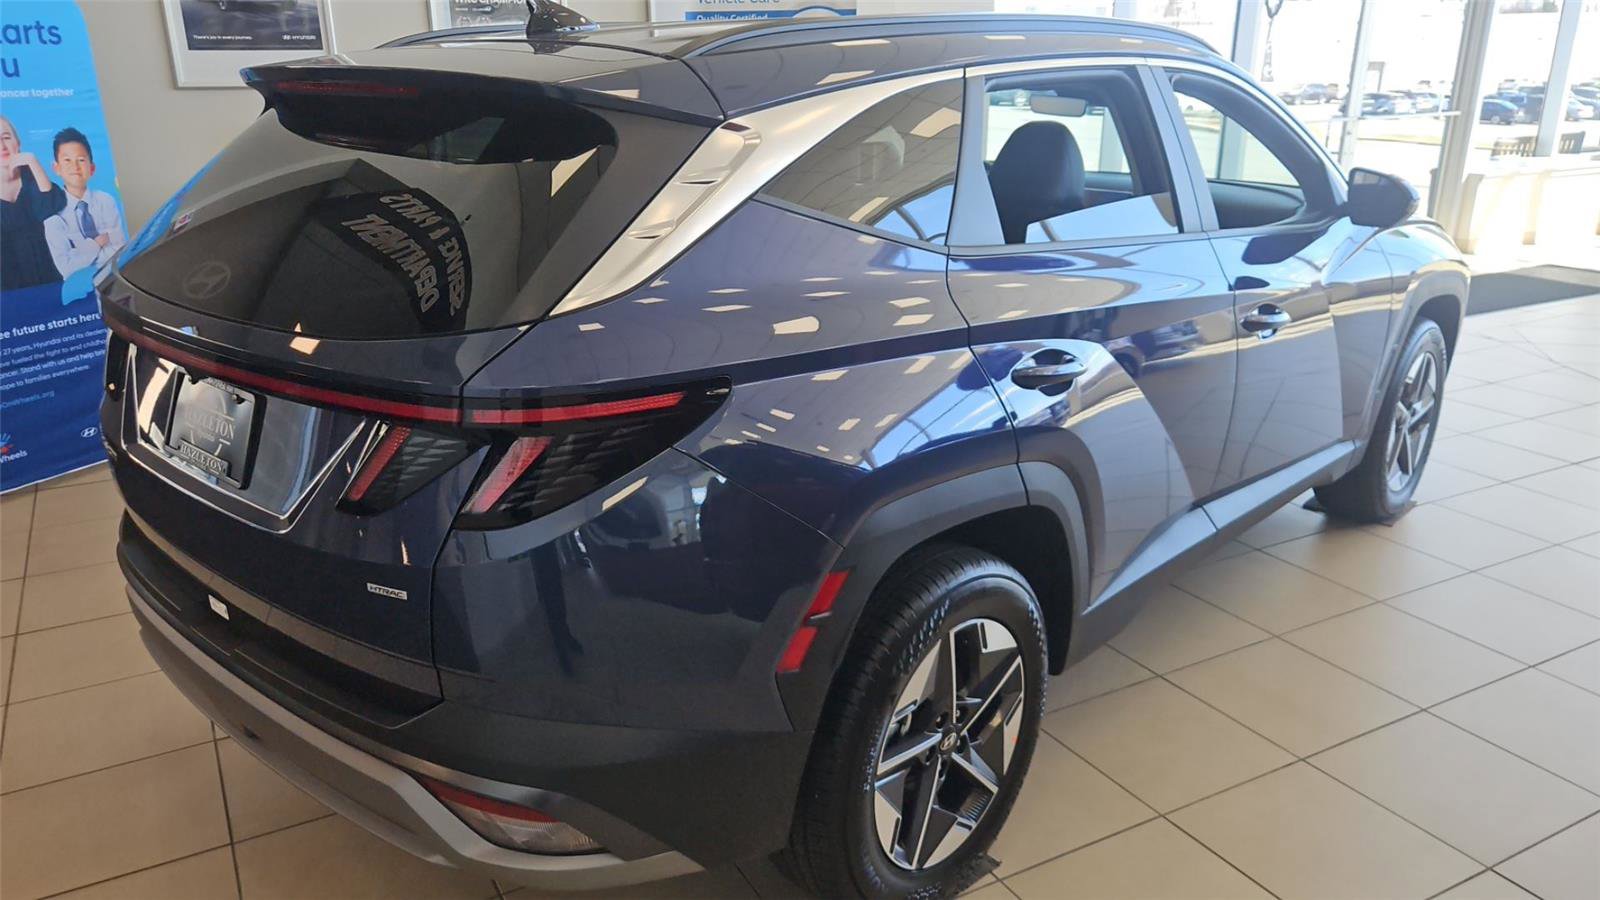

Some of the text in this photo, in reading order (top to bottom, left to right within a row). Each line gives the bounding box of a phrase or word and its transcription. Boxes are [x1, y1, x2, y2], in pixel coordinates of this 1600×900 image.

[0, 20, 62, 45] arts
[31, 88, 74, 98] together
[12, 323, 46, 337] future
[47, 316, 78, 330] starts
[3, 347, 11, 355] 27
[33, 338, 61, 348] Hyundai
[62, 334, 76, 342] and
[11, 355, 33, 365] fueled
[70, 343, 82, 351] end
[20, 363, 41, 374] Stand
[41, 360, 57, 369] with
[66, 355, 80, 363] and
[80, 350, 95, 362] help
[25, 373, 52, 385] families
[184, 406, 236, 441] HAZLETON
[180, 442, 223, 472] HAZLETON
[370, 585, 406, 599] HTRAC
